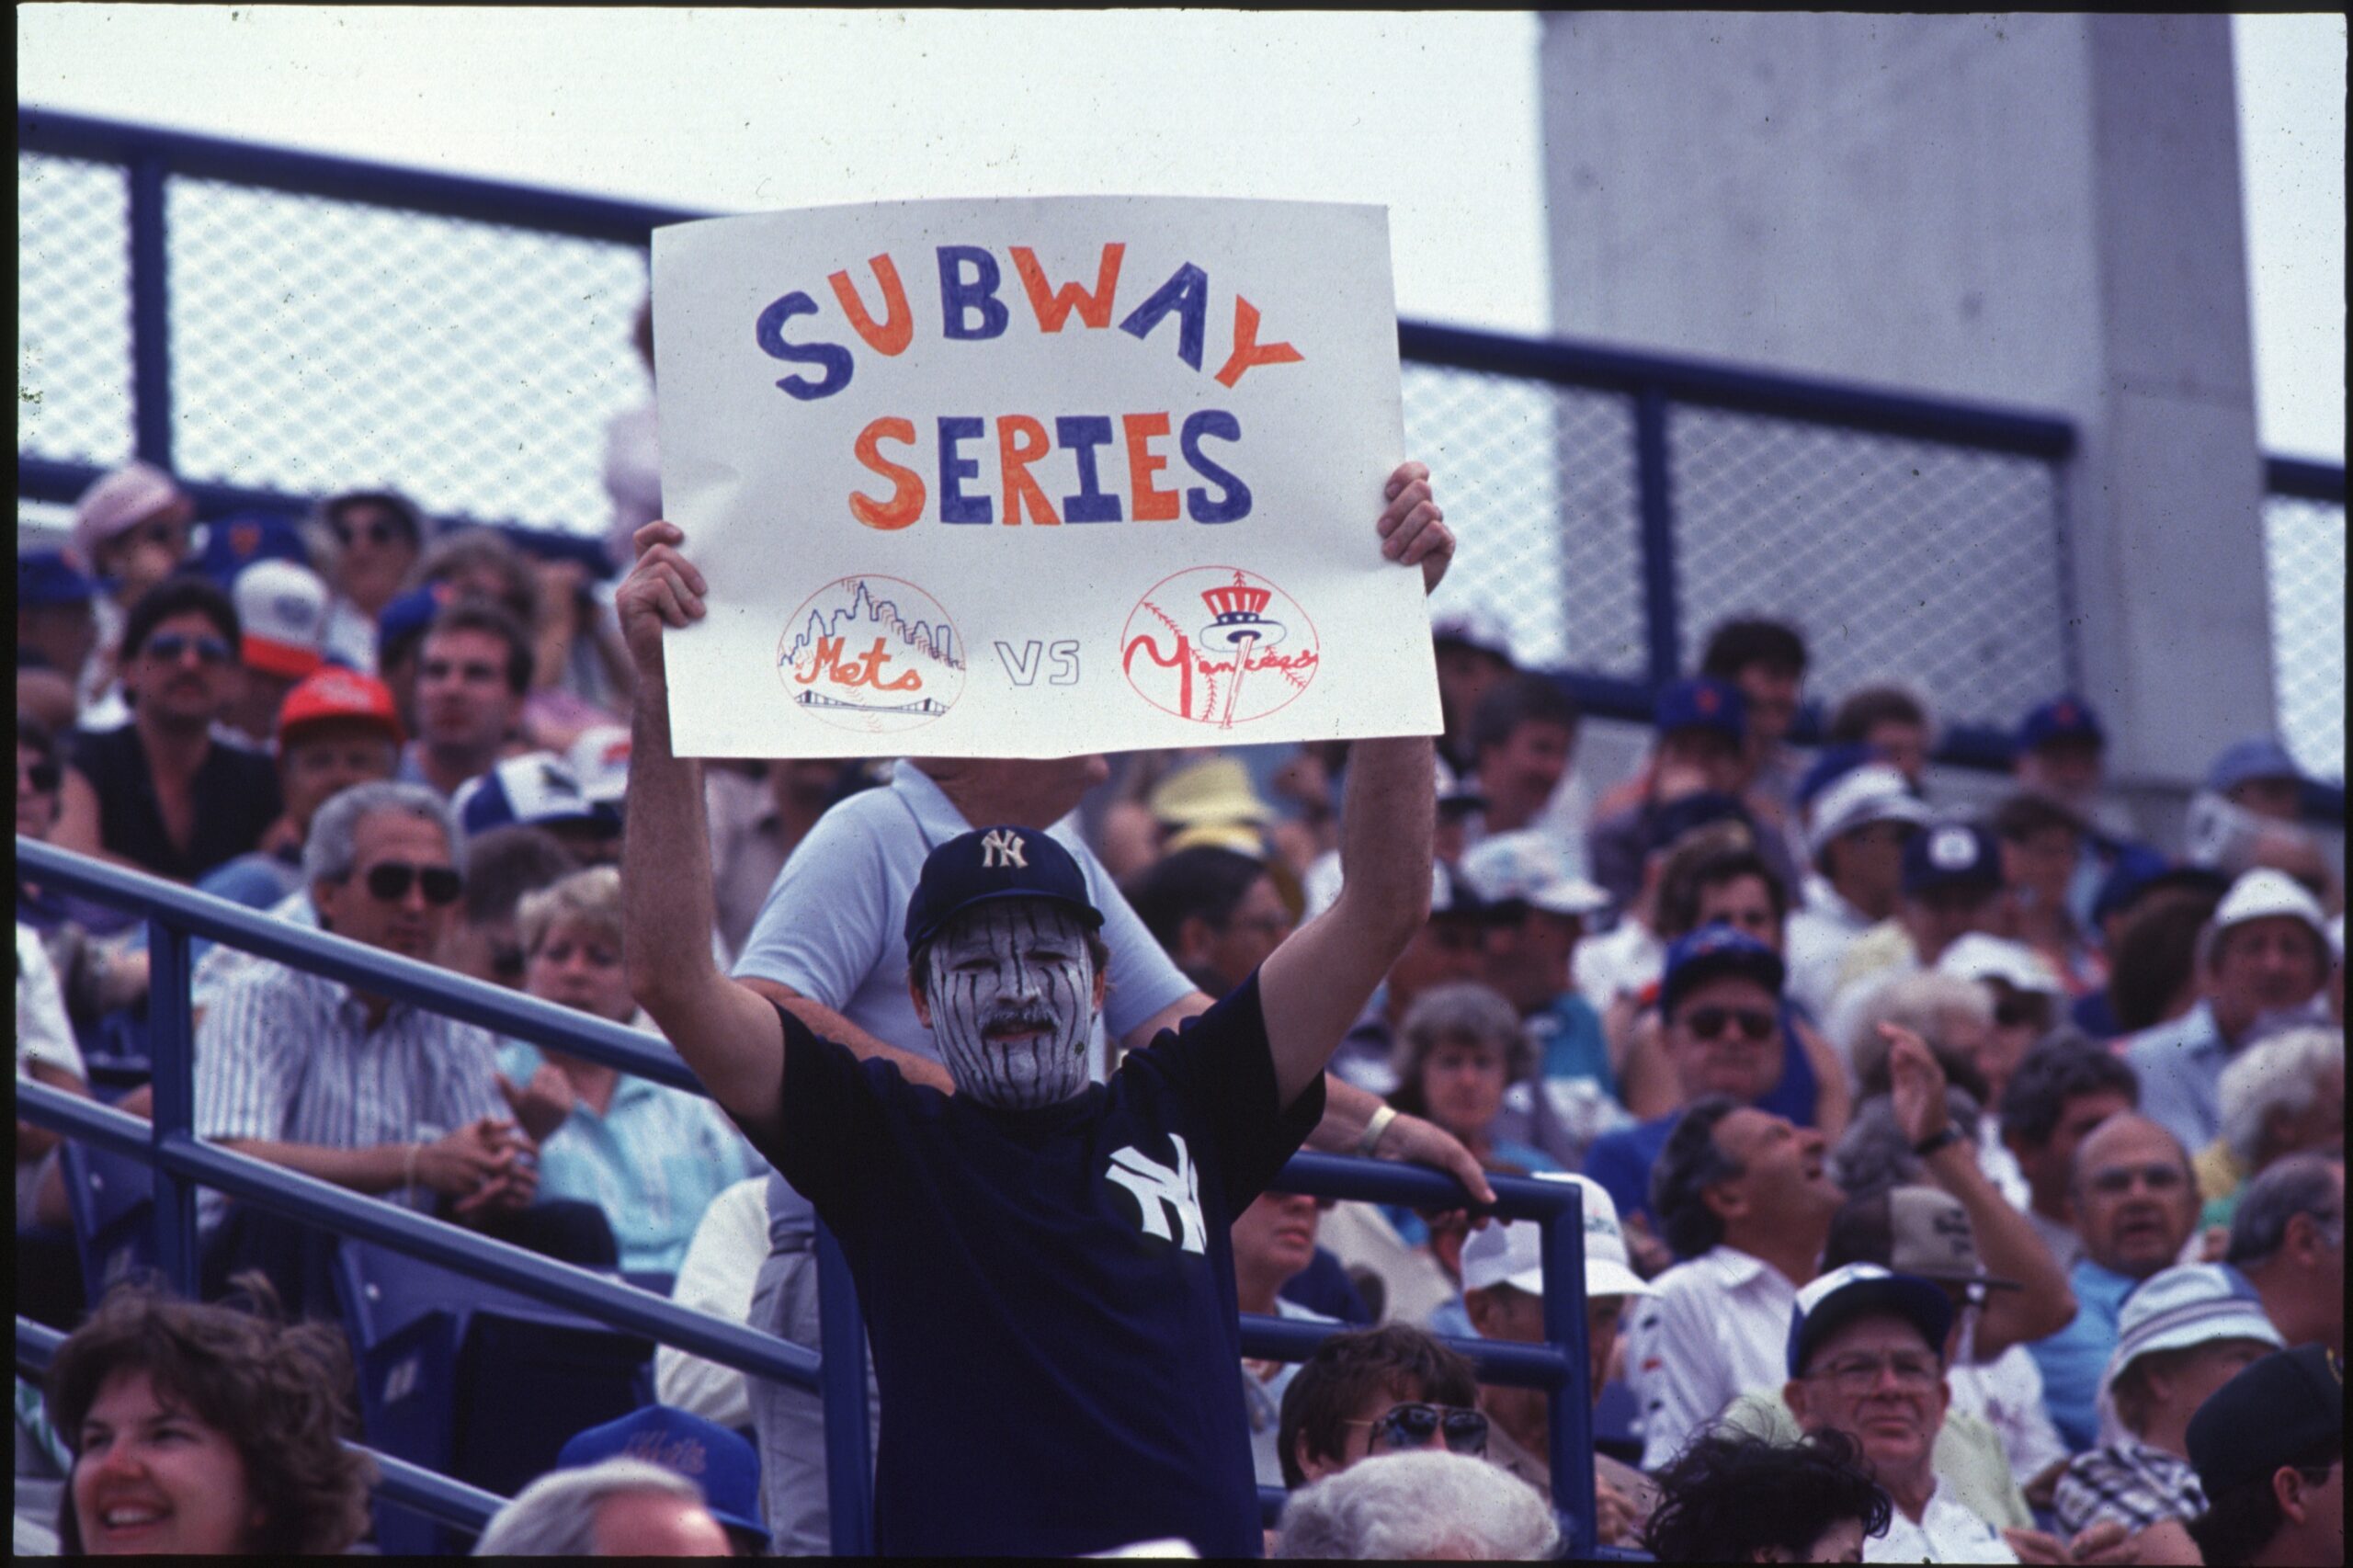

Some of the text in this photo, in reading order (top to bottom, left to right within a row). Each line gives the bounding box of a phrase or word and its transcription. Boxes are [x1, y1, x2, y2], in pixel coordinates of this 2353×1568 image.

[756, 243, 1305, 401] SUBWAY
[849, 410, 1253, 530] SERIES
[795, 636, 923, 691] Mets
[980, 828, 1029, 869] NY
[1105, 1131, 1208, 1256] NY
